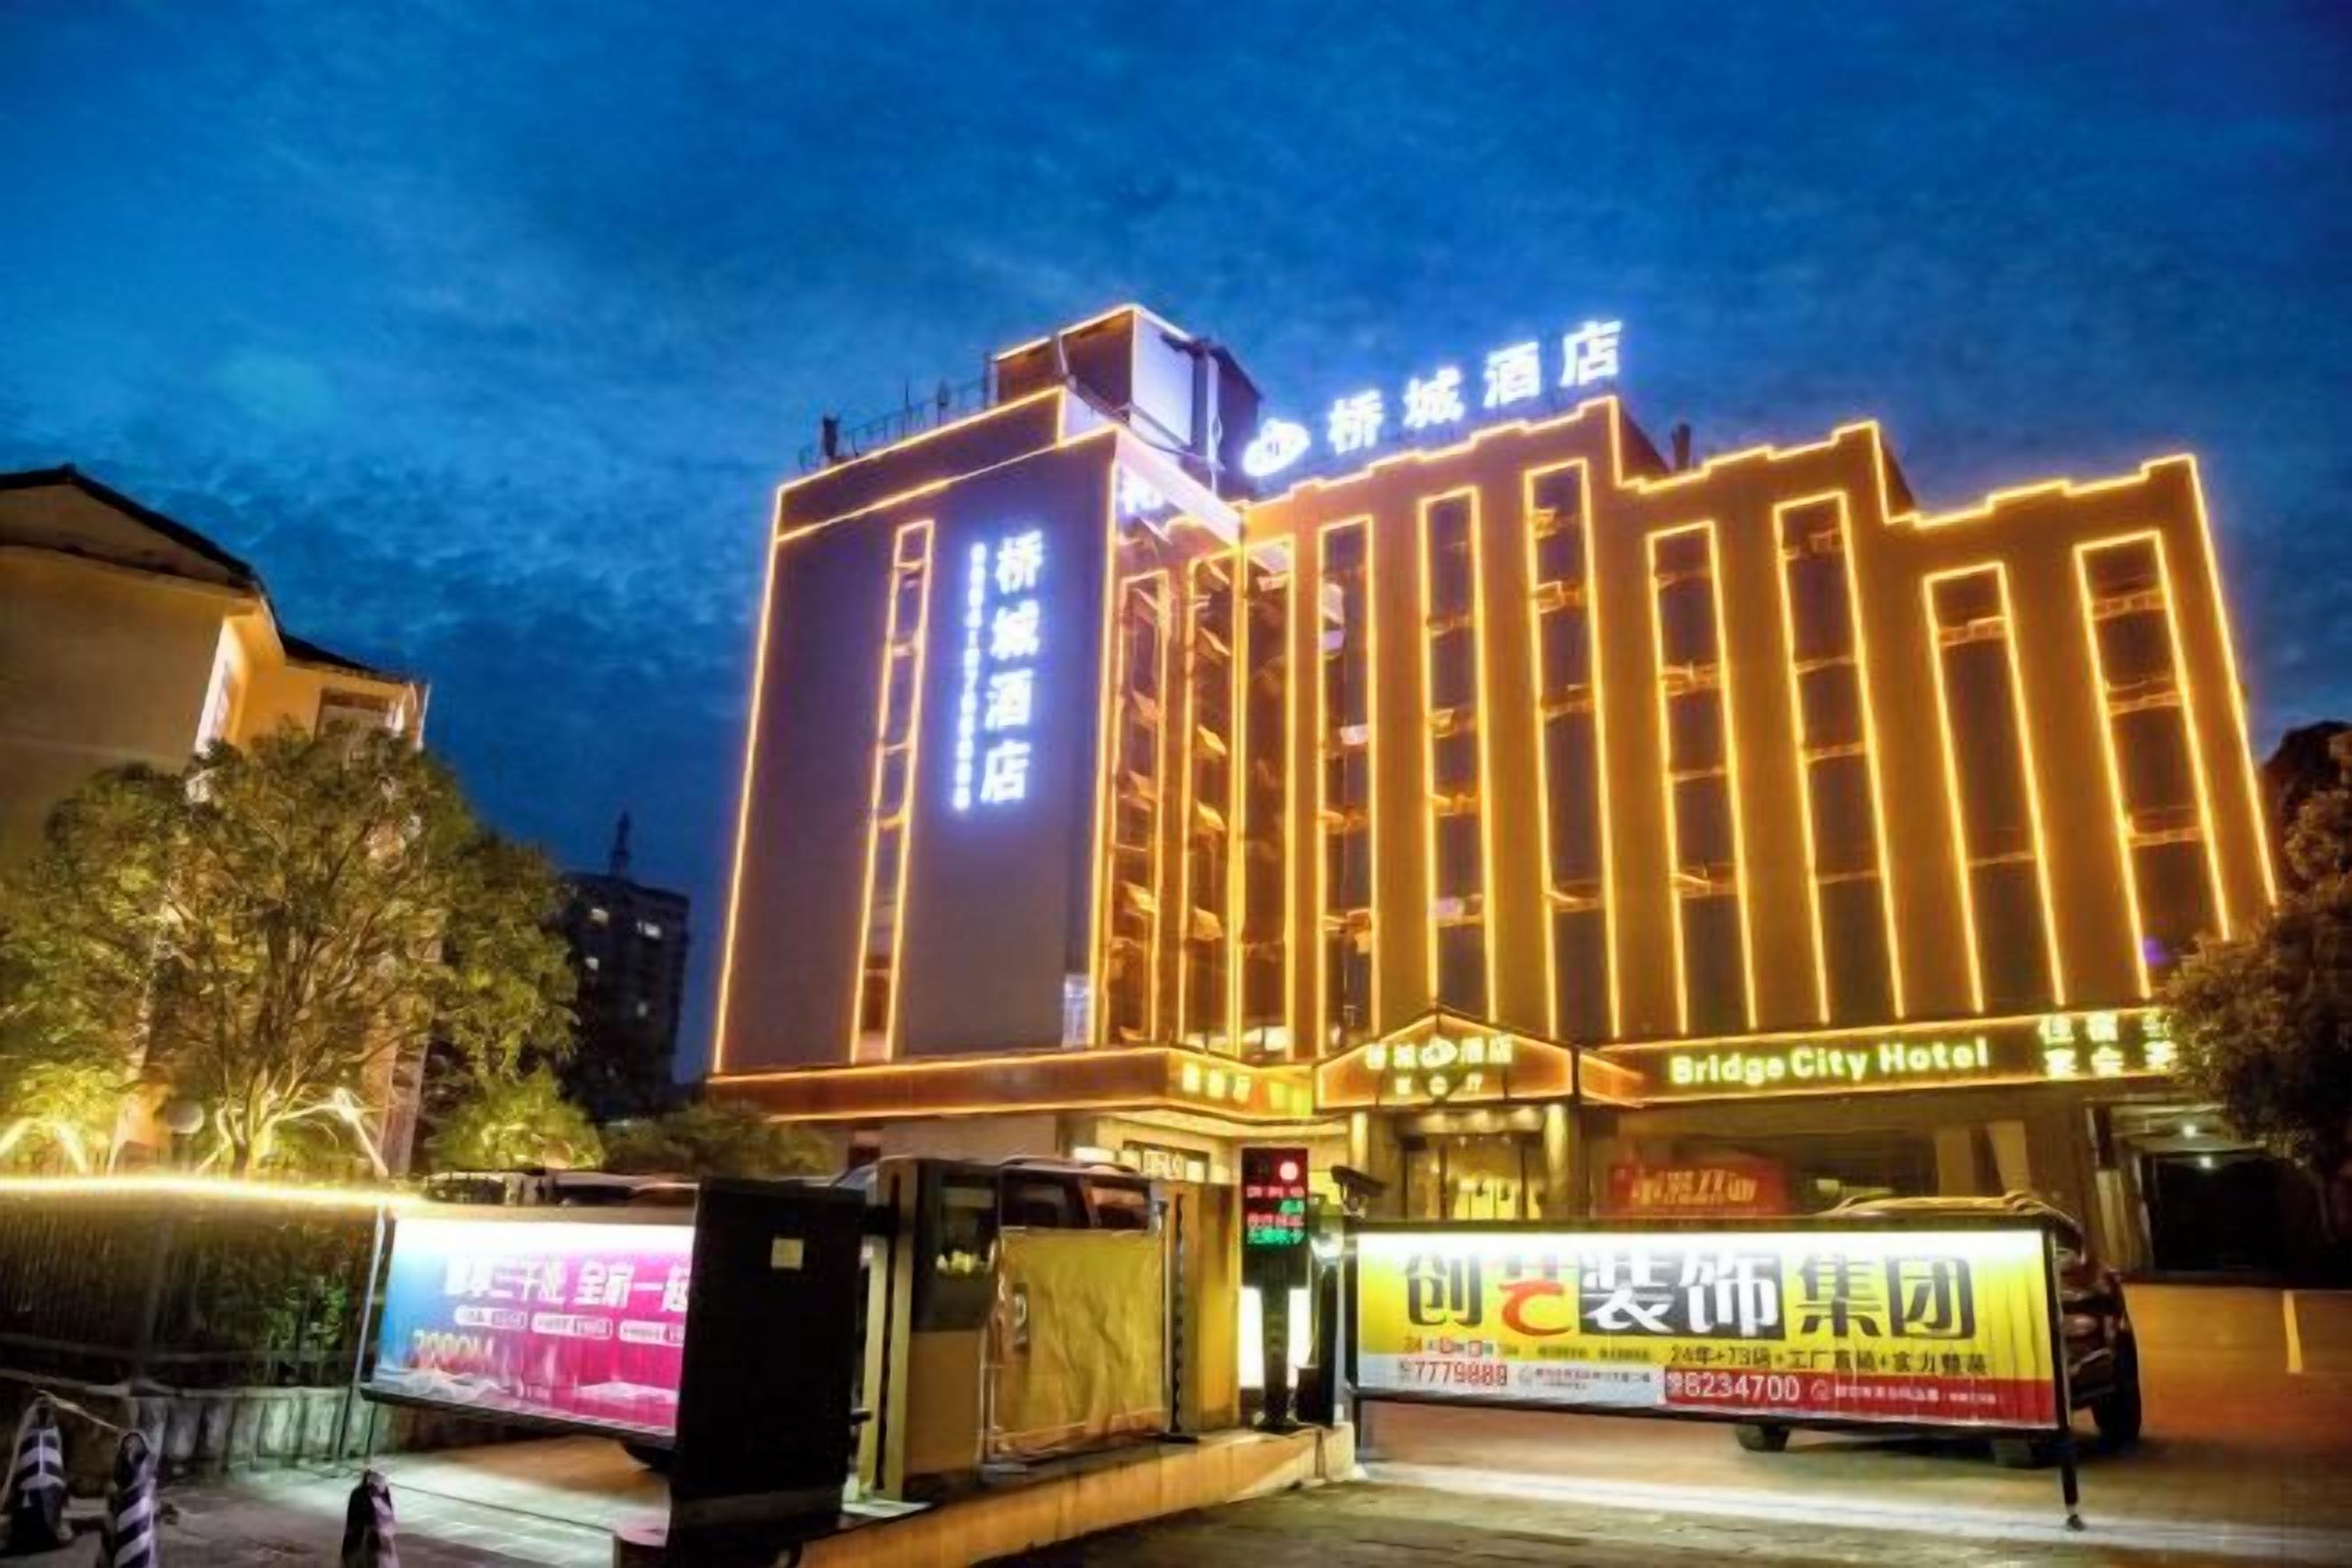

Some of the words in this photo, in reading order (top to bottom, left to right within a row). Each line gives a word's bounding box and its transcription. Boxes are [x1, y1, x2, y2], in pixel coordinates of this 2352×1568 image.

[1328, 319, 1622, 454] 桥城酒店
[1669, 1050, 1785, 1086] Bridge
[1789, 1045, 1868, 1082] City
[1878, 1035, 1989, 1074] Hotel
